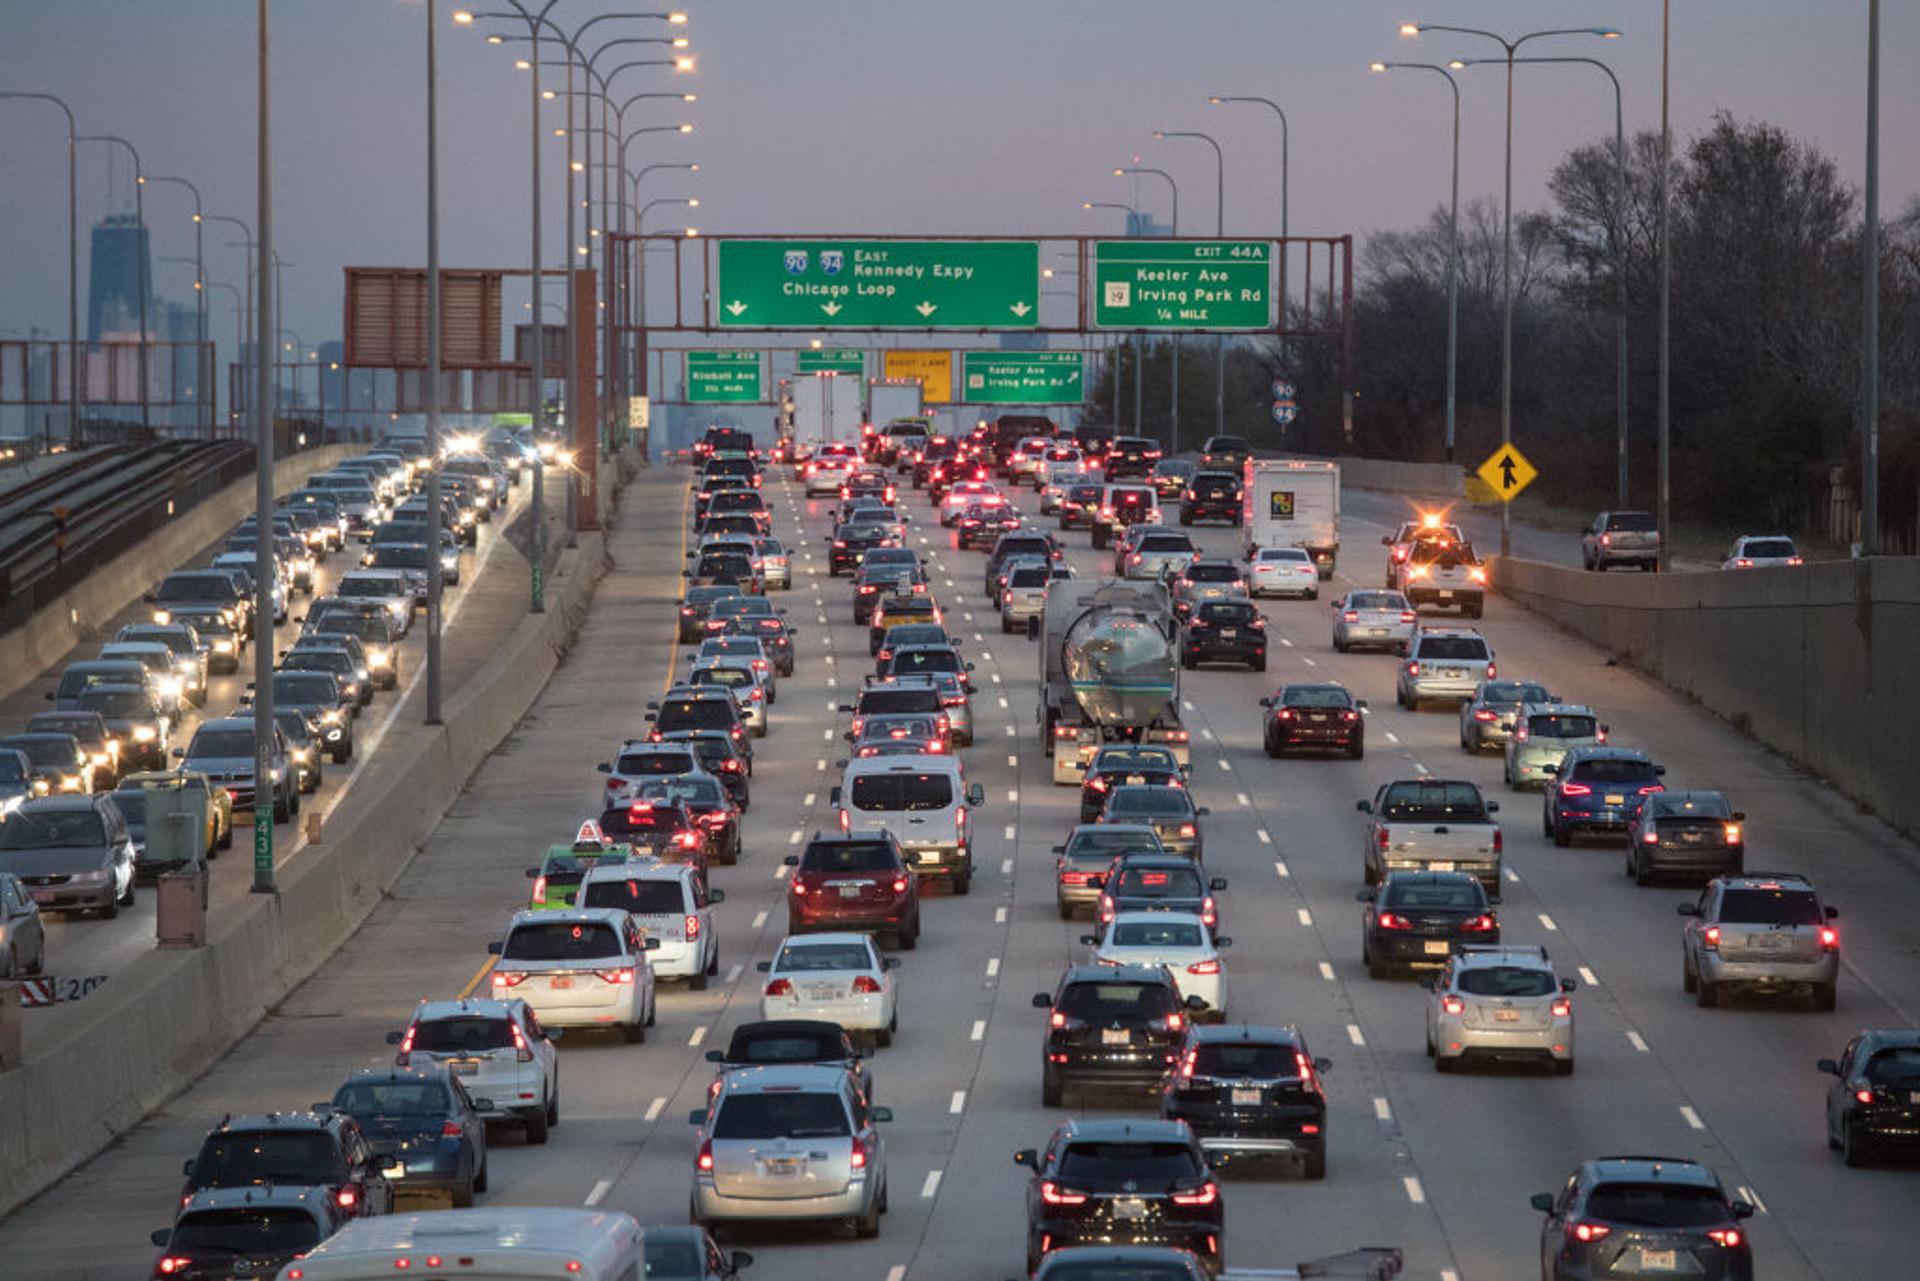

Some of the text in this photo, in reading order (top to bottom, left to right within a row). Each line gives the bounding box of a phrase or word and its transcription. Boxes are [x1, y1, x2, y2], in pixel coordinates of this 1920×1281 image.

[1195, 246, 1262, 257] EXIT 44A
[786, 256, 807, 272] 90
[821, 256, 842, 270] 94
[854, 264, 974, 279] Kennedy Expy
[1137, 268, 1228, 281] Keeler Ave
[783, 282, 896, 298] Chicago Loop
[1138, 288, 1261, 304] Irving Park Rd
[1180, 309, 1208, 320] MILE
[257, 820, 268, 853] 43
